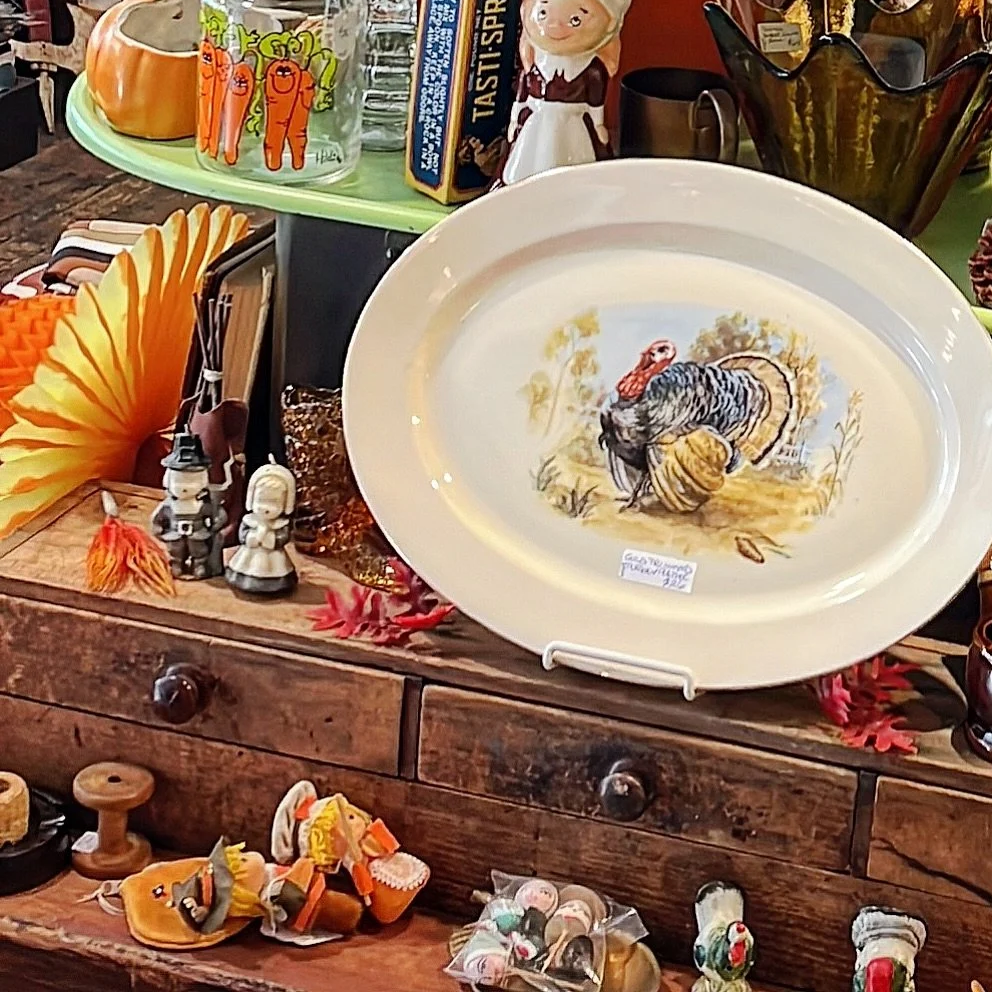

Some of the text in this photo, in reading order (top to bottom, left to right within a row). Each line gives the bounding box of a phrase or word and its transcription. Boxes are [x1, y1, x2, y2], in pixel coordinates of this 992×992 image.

[447, 9, 456, 23] TO
[425, 26, 435, 56] AWAY
[438, 29, 448, 54] WITH
[442, 28, 453, 69] SOFTEN
[421, 57, 432, 86] FROM
[429, 50, 439, 80] KEEP
[435, 57, 444, 79] THE
[431, 81, 441, 117] COLOR
[437, 74, 449, 121] SLIGHTLY
[421, 108, 432, 145] CROCK
[434, 126, 443, 147] BUT
[432, 152, 441, 175] NOT
